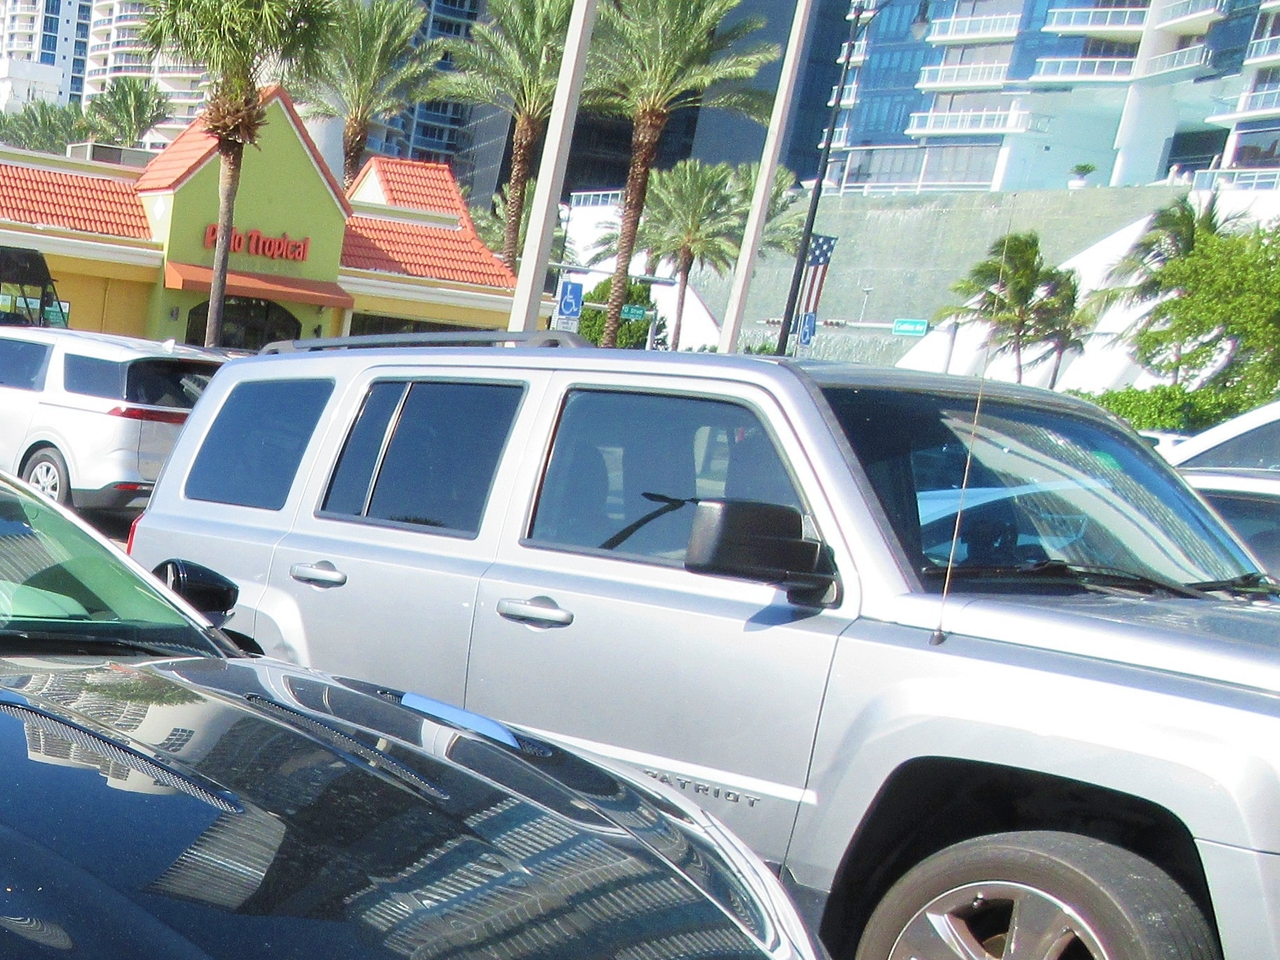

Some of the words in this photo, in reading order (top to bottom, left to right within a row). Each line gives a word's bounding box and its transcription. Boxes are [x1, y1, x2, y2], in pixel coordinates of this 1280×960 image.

[204, 223, 244, 252] Plo
[247, 229, 310, 261] Tropical
[644, 768, 761, 808] PATRIOT
